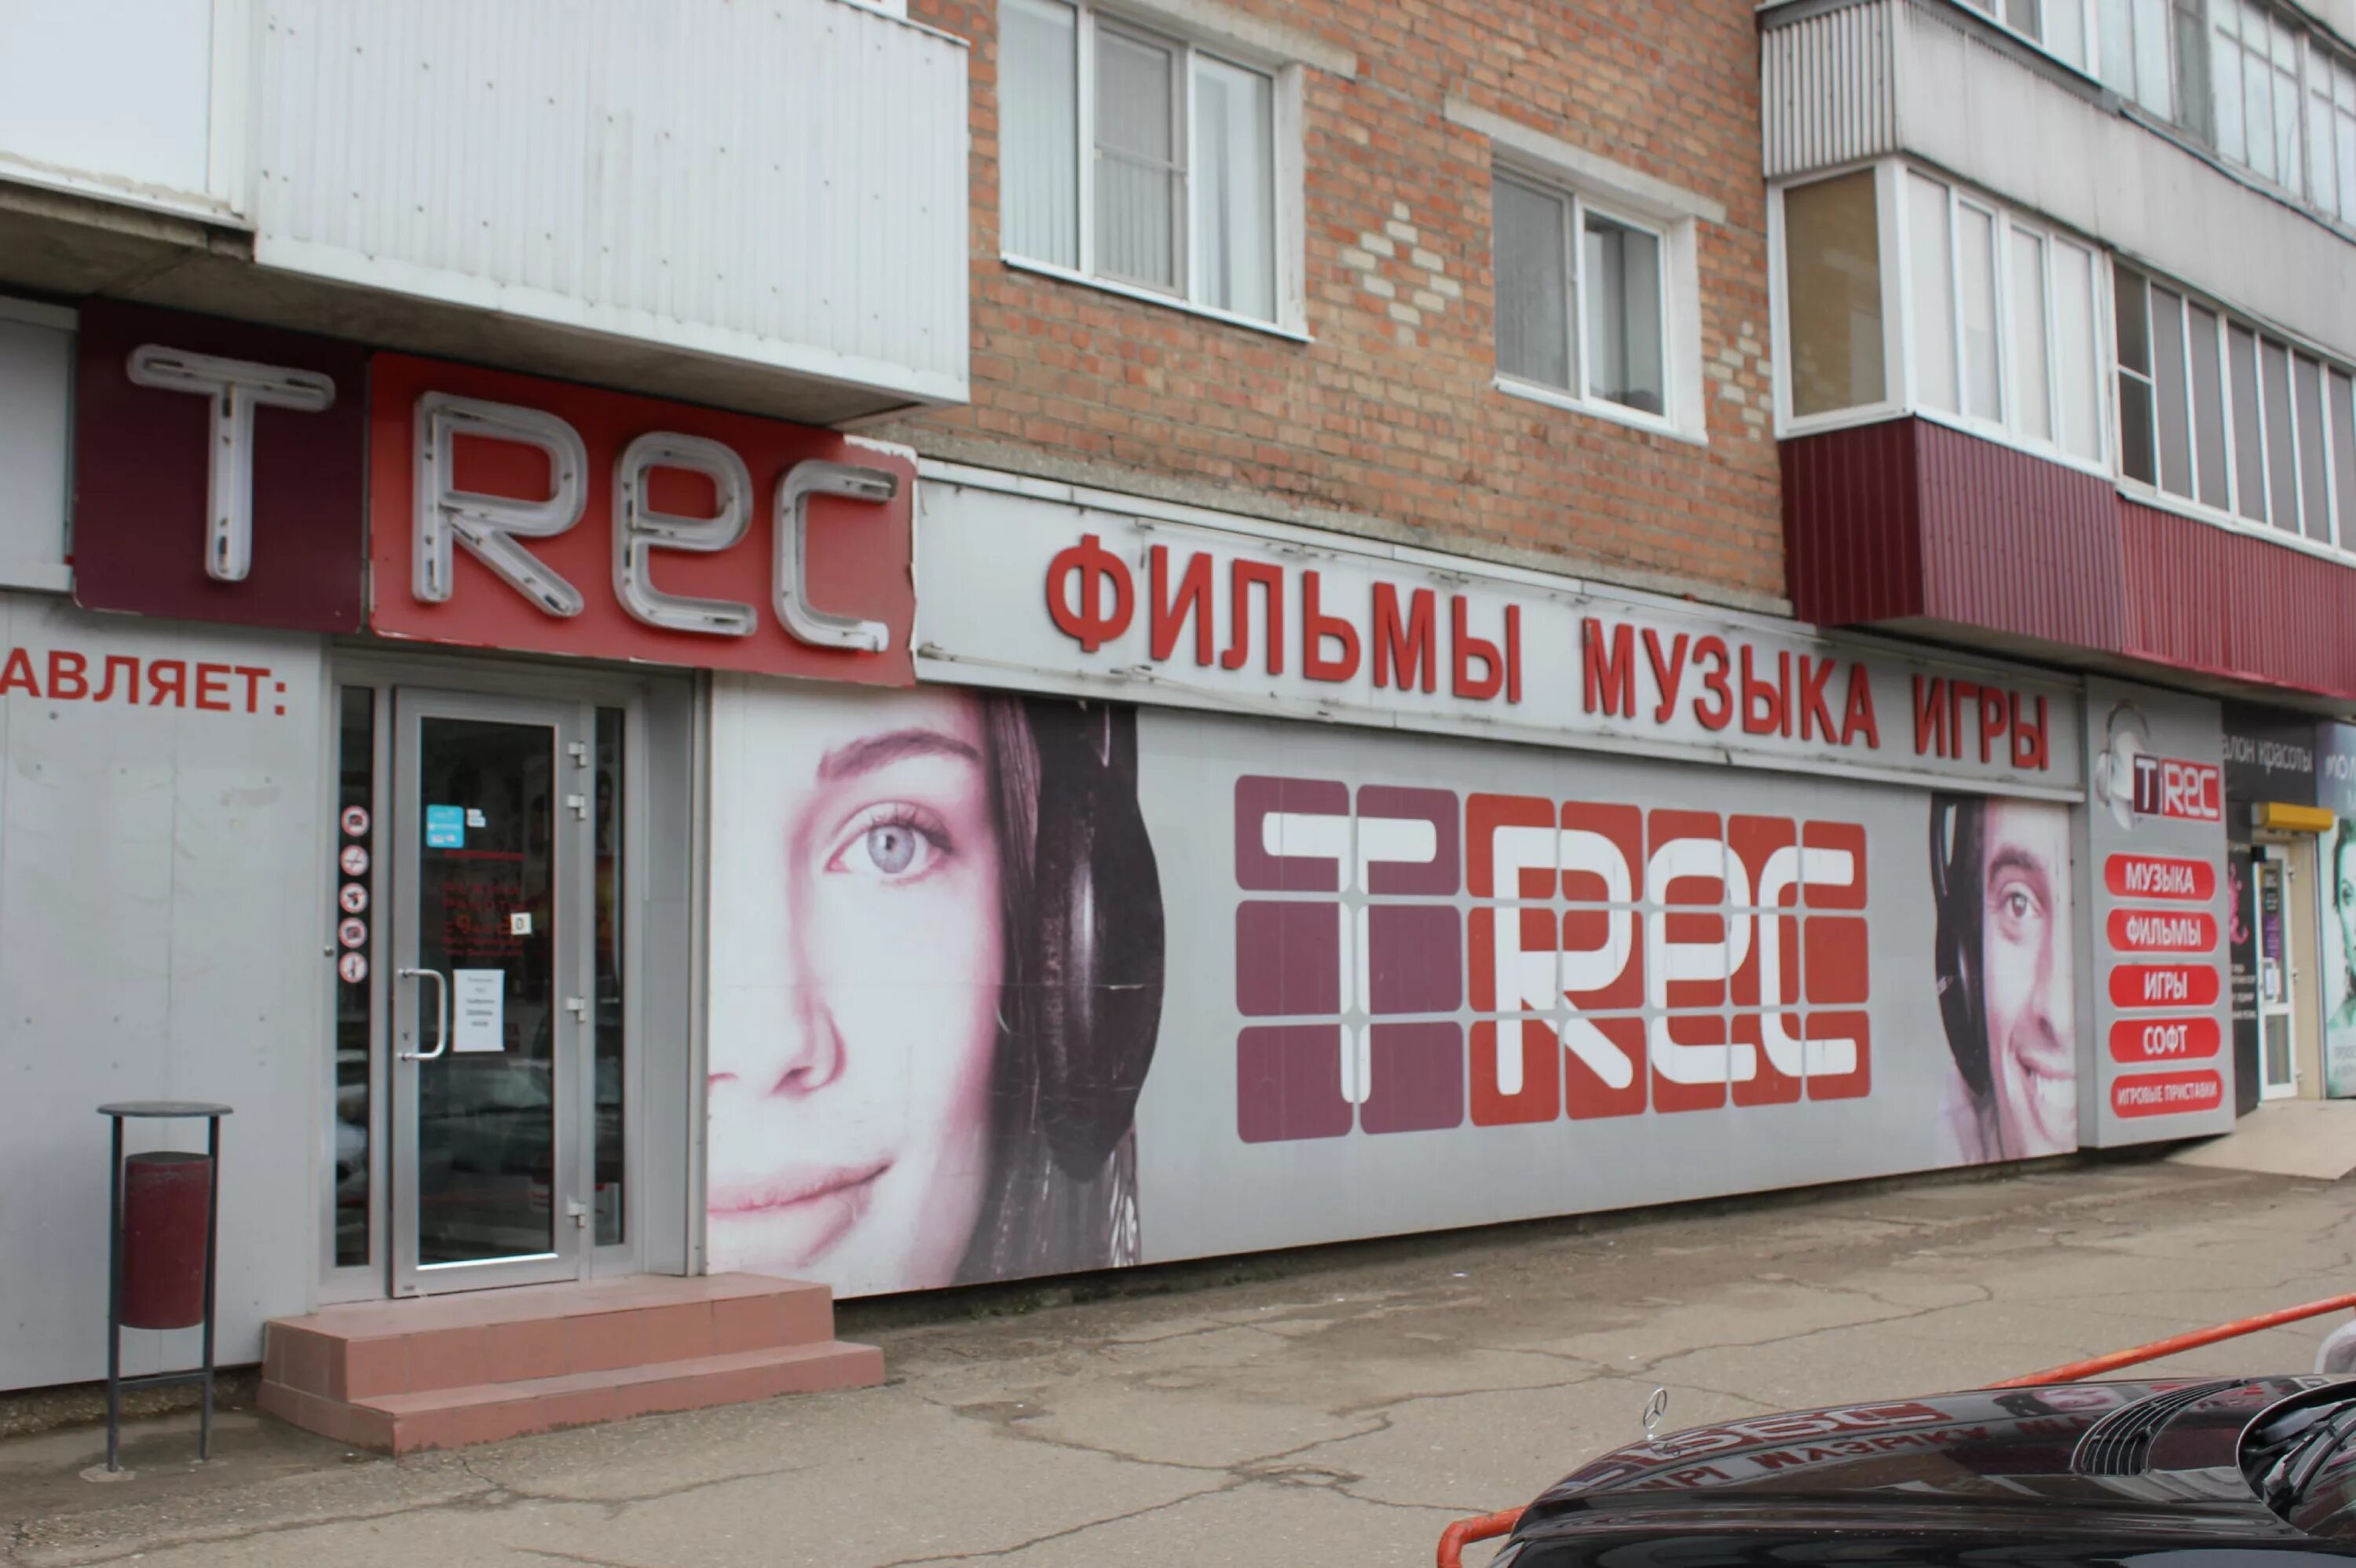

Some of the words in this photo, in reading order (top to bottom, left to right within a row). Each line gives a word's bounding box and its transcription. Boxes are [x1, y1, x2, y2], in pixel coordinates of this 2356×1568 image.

[1046, 532, 1522, 704] ФИЛЬМЫ
[1582, 617, 1880, 749] МУЗЫКА
[1913, 673, 2050, 770] ИГРЫ
[0, 647, 287, 716] АВЛЯЕТ:
[2259, 742, 2313, 775] красоты
[2125, 862, 2196, 895] МУЗЫКА
[2126, 916, 2201, 948] ФИЛЬМЫ
[2144, 971, 2188, 1001] ИГРЫ
[2142, 1025, 2187, 1055] СОФТ
[2116, 1085, 2163, 1106] ИГРОВЫЕ
[2164, 1080, 2218, 1102] ПРИСТАВКИ
